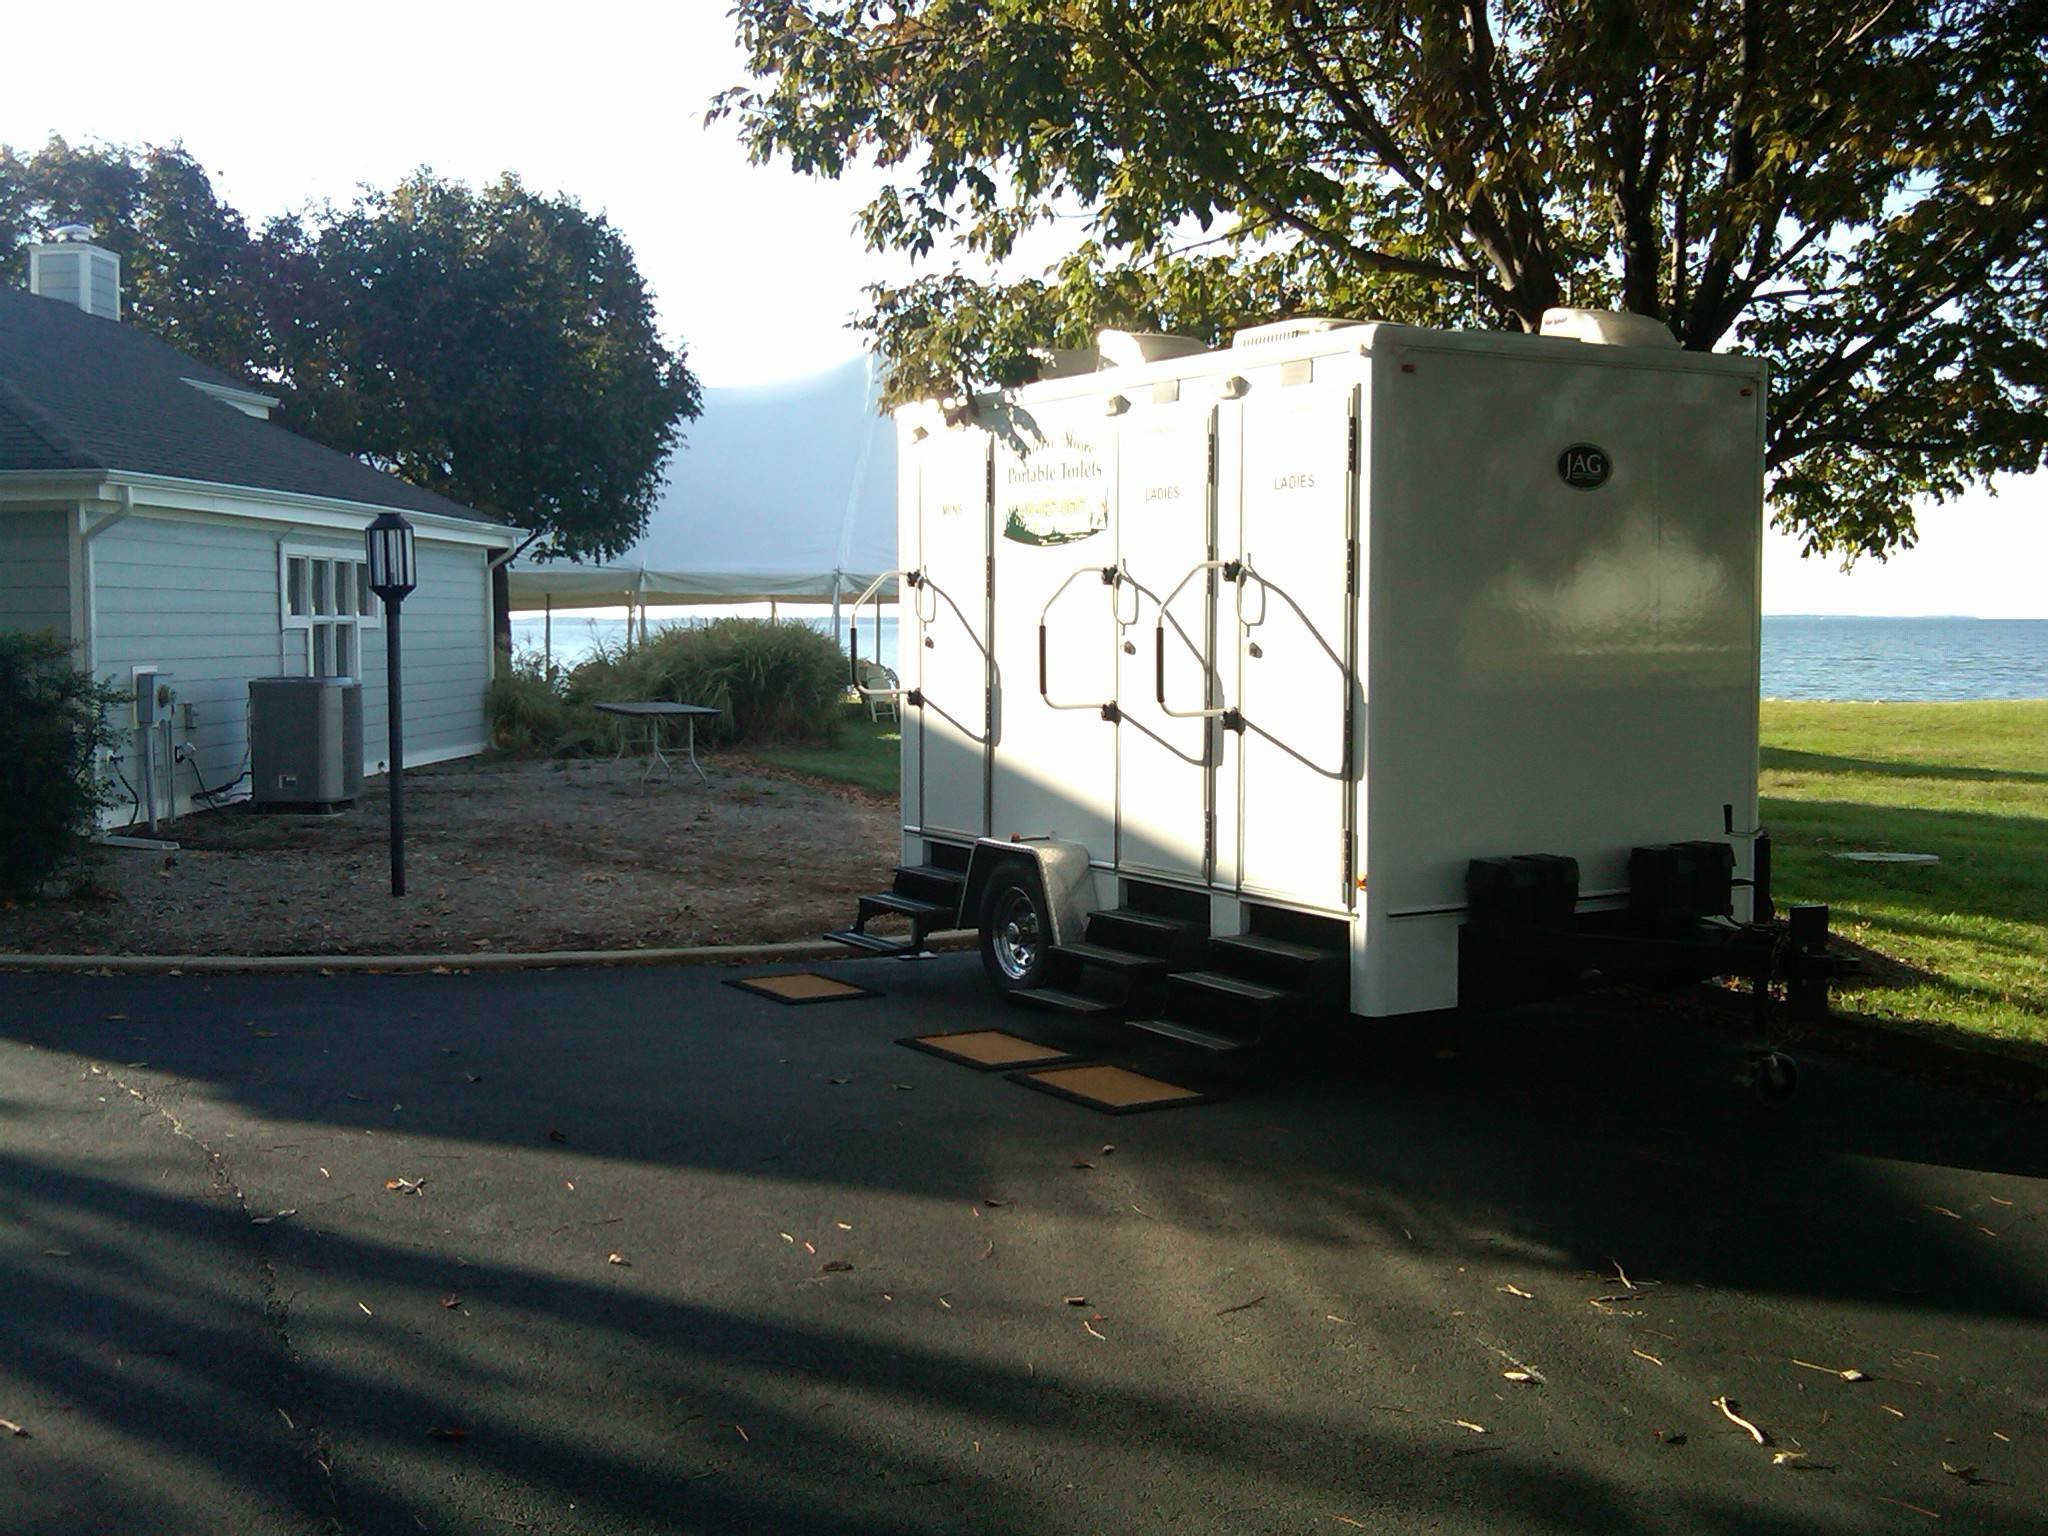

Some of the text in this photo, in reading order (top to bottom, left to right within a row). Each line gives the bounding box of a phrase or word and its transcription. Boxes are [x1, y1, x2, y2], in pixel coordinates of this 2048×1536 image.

[1008, 459, 1102, 485] Portable Toilets
[1565, 453, 1602, 480] JAG
[1274, 474, 1315, 491] LADIES
[1145, 486, 1180, 502] LADIES
